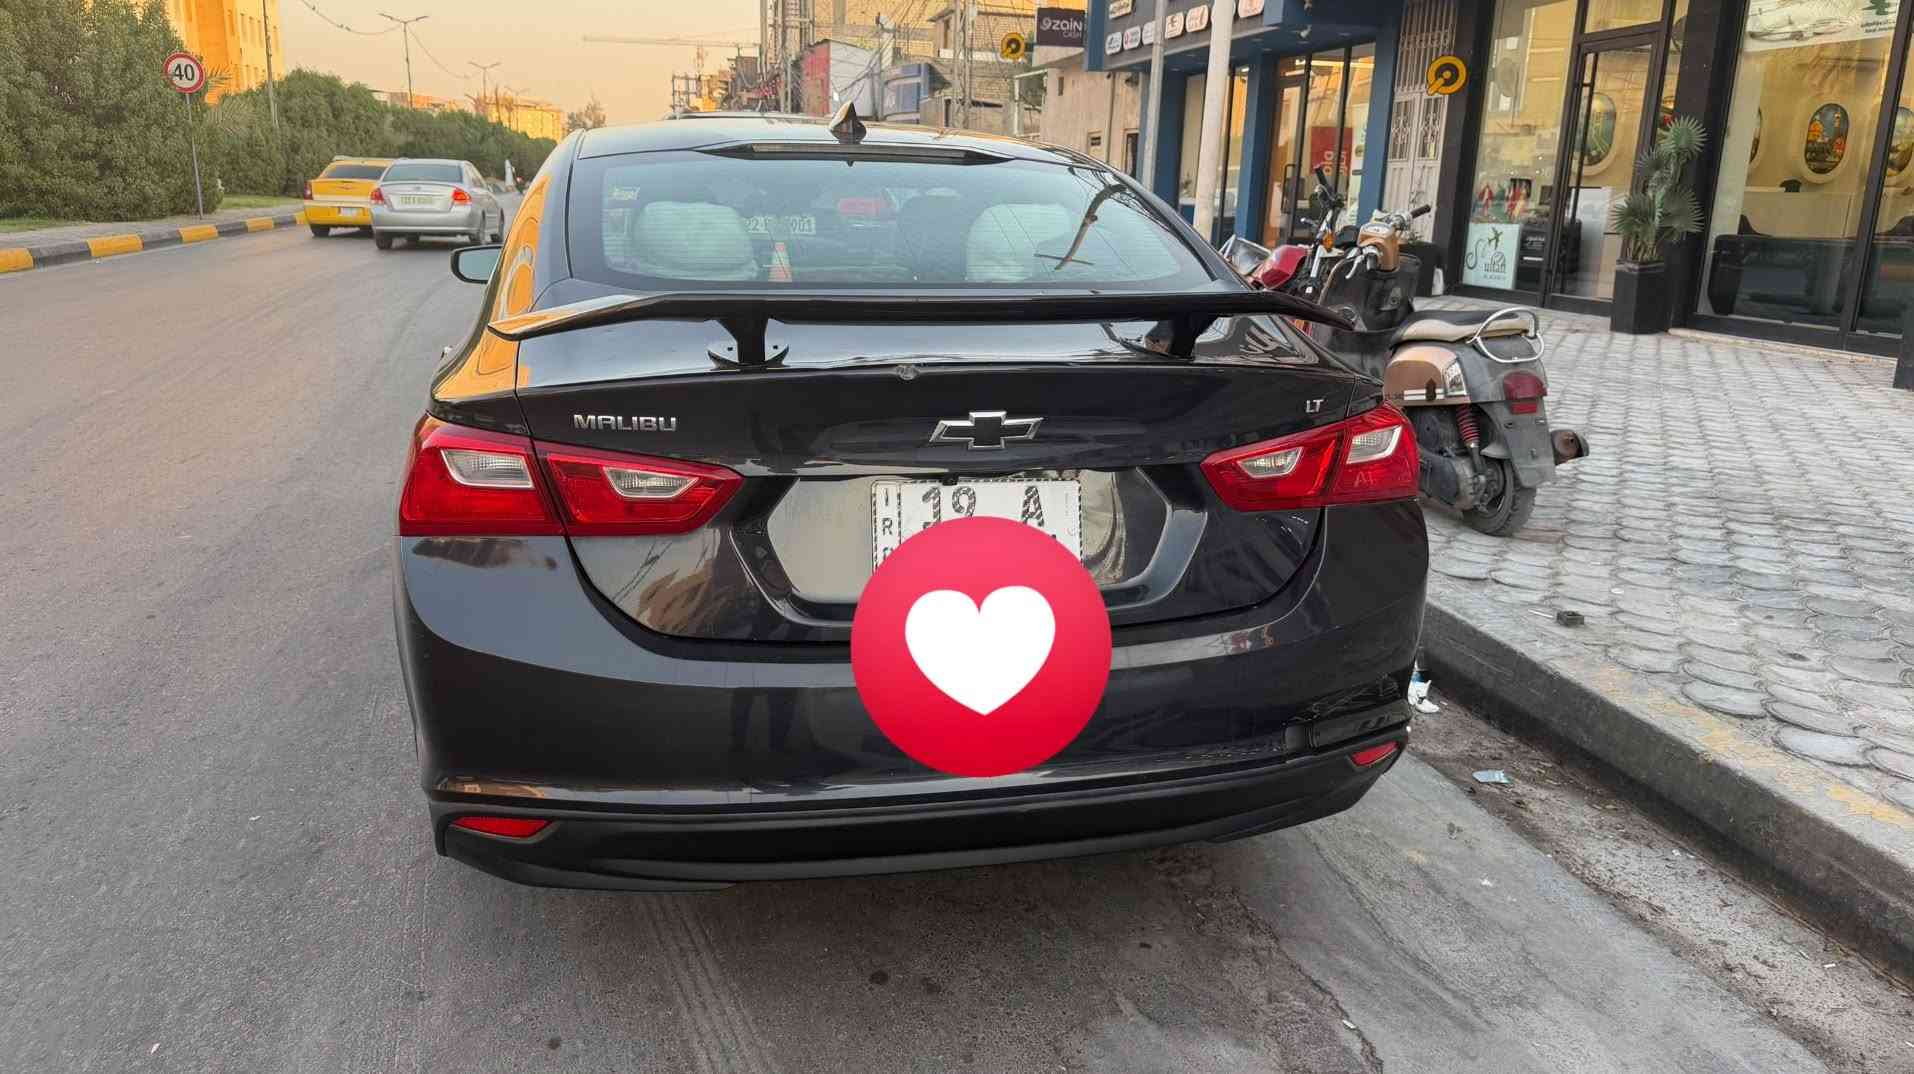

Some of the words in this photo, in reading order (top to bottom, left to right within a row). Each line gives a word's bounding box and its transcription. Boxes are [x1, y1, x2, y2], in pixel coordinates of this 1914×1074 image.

[174, 63, 195, 81] 40
[1305, 399, 1324, 413] LT
[573, 414, 677, 431] MALIBU
[1021, 486, 1044, 527] A
